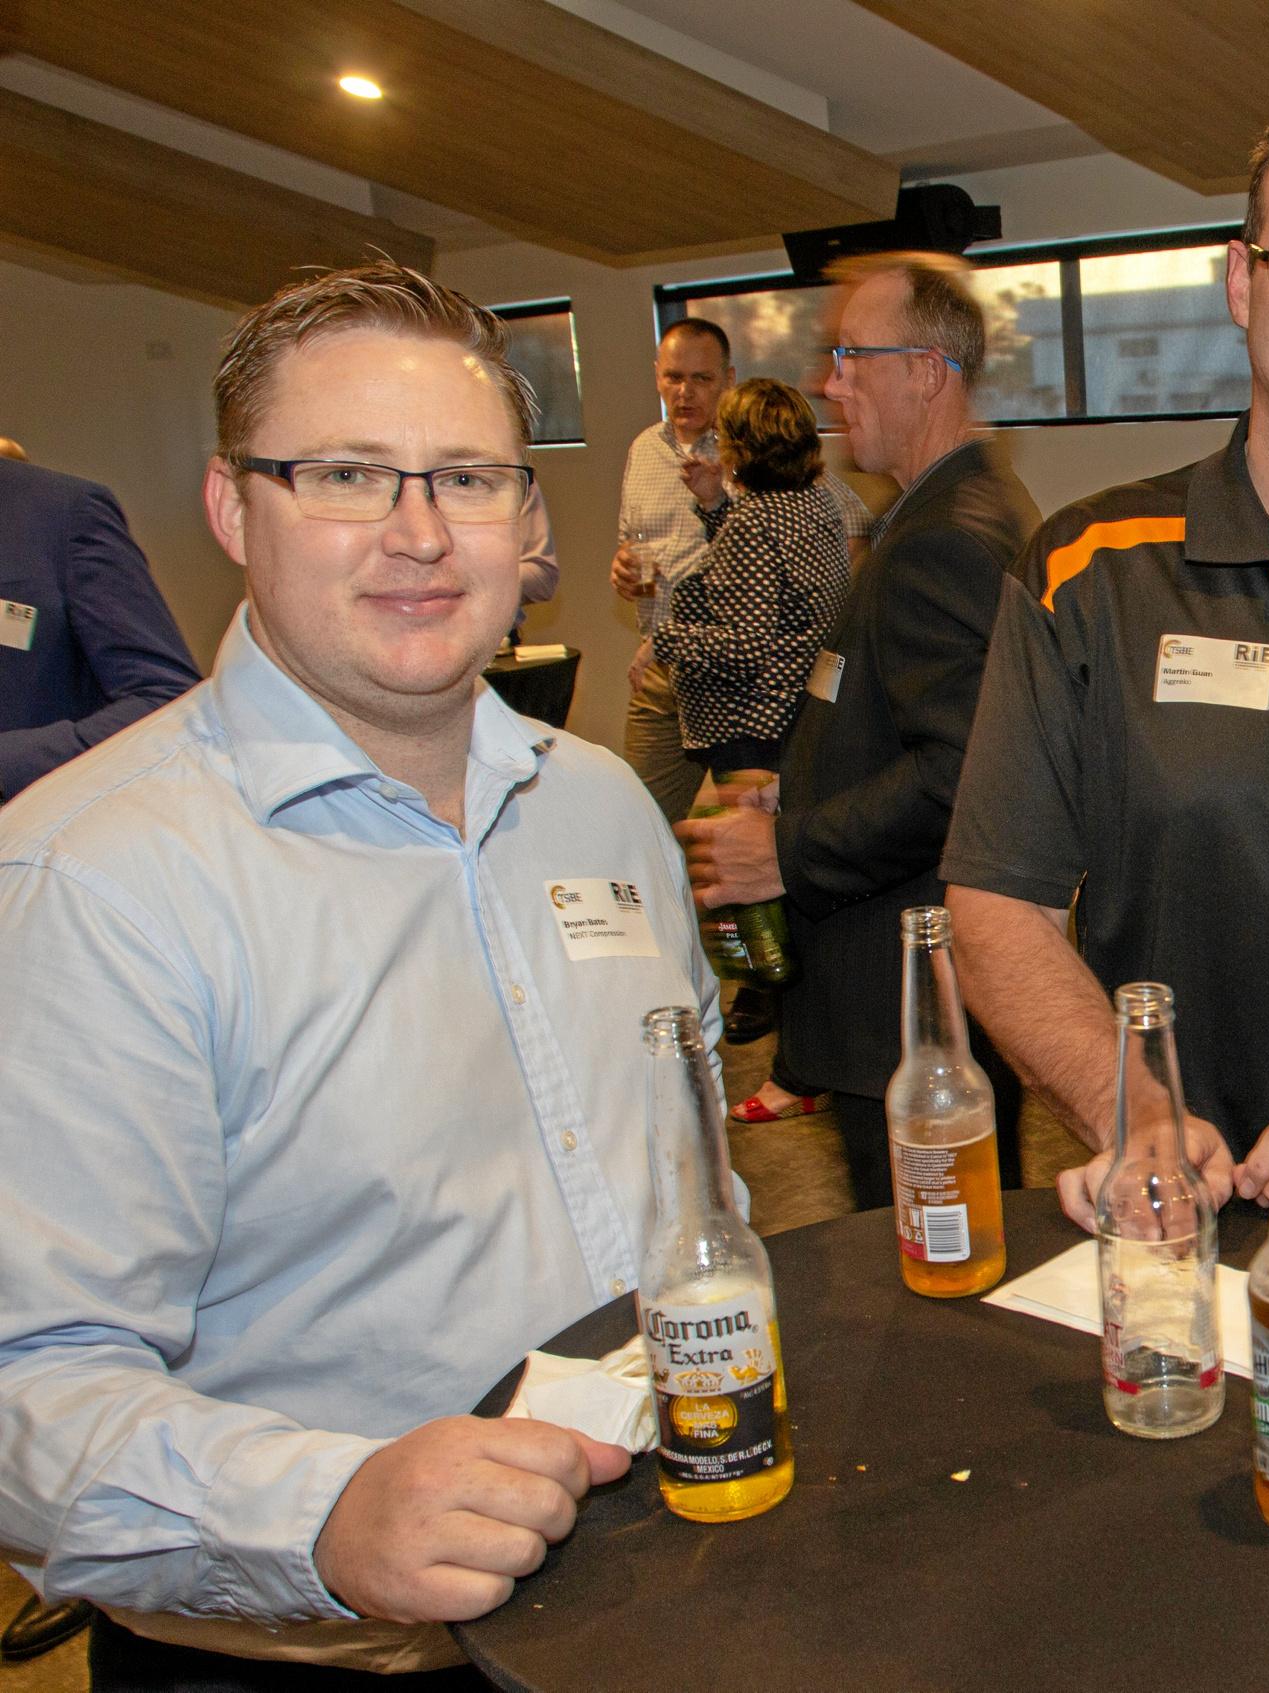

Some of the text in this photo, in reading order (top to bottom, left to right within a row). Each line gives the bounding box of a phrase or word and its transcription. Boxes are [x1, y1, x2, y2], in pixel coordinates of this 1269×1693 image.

[610, 882, 642, 905] RiE
[563, 919, 587, 930] Bryan
[644, 1308, 752, 1347] Corona
[668, 1343, 734, 1365] Extra
[695, 1402, 711, 1410] LA
[680, 1411, 729, 1420] CERVEZA
[693, 1430, 719, 1439] FINA
[697, 1464, 725, 1474] MEXICO
